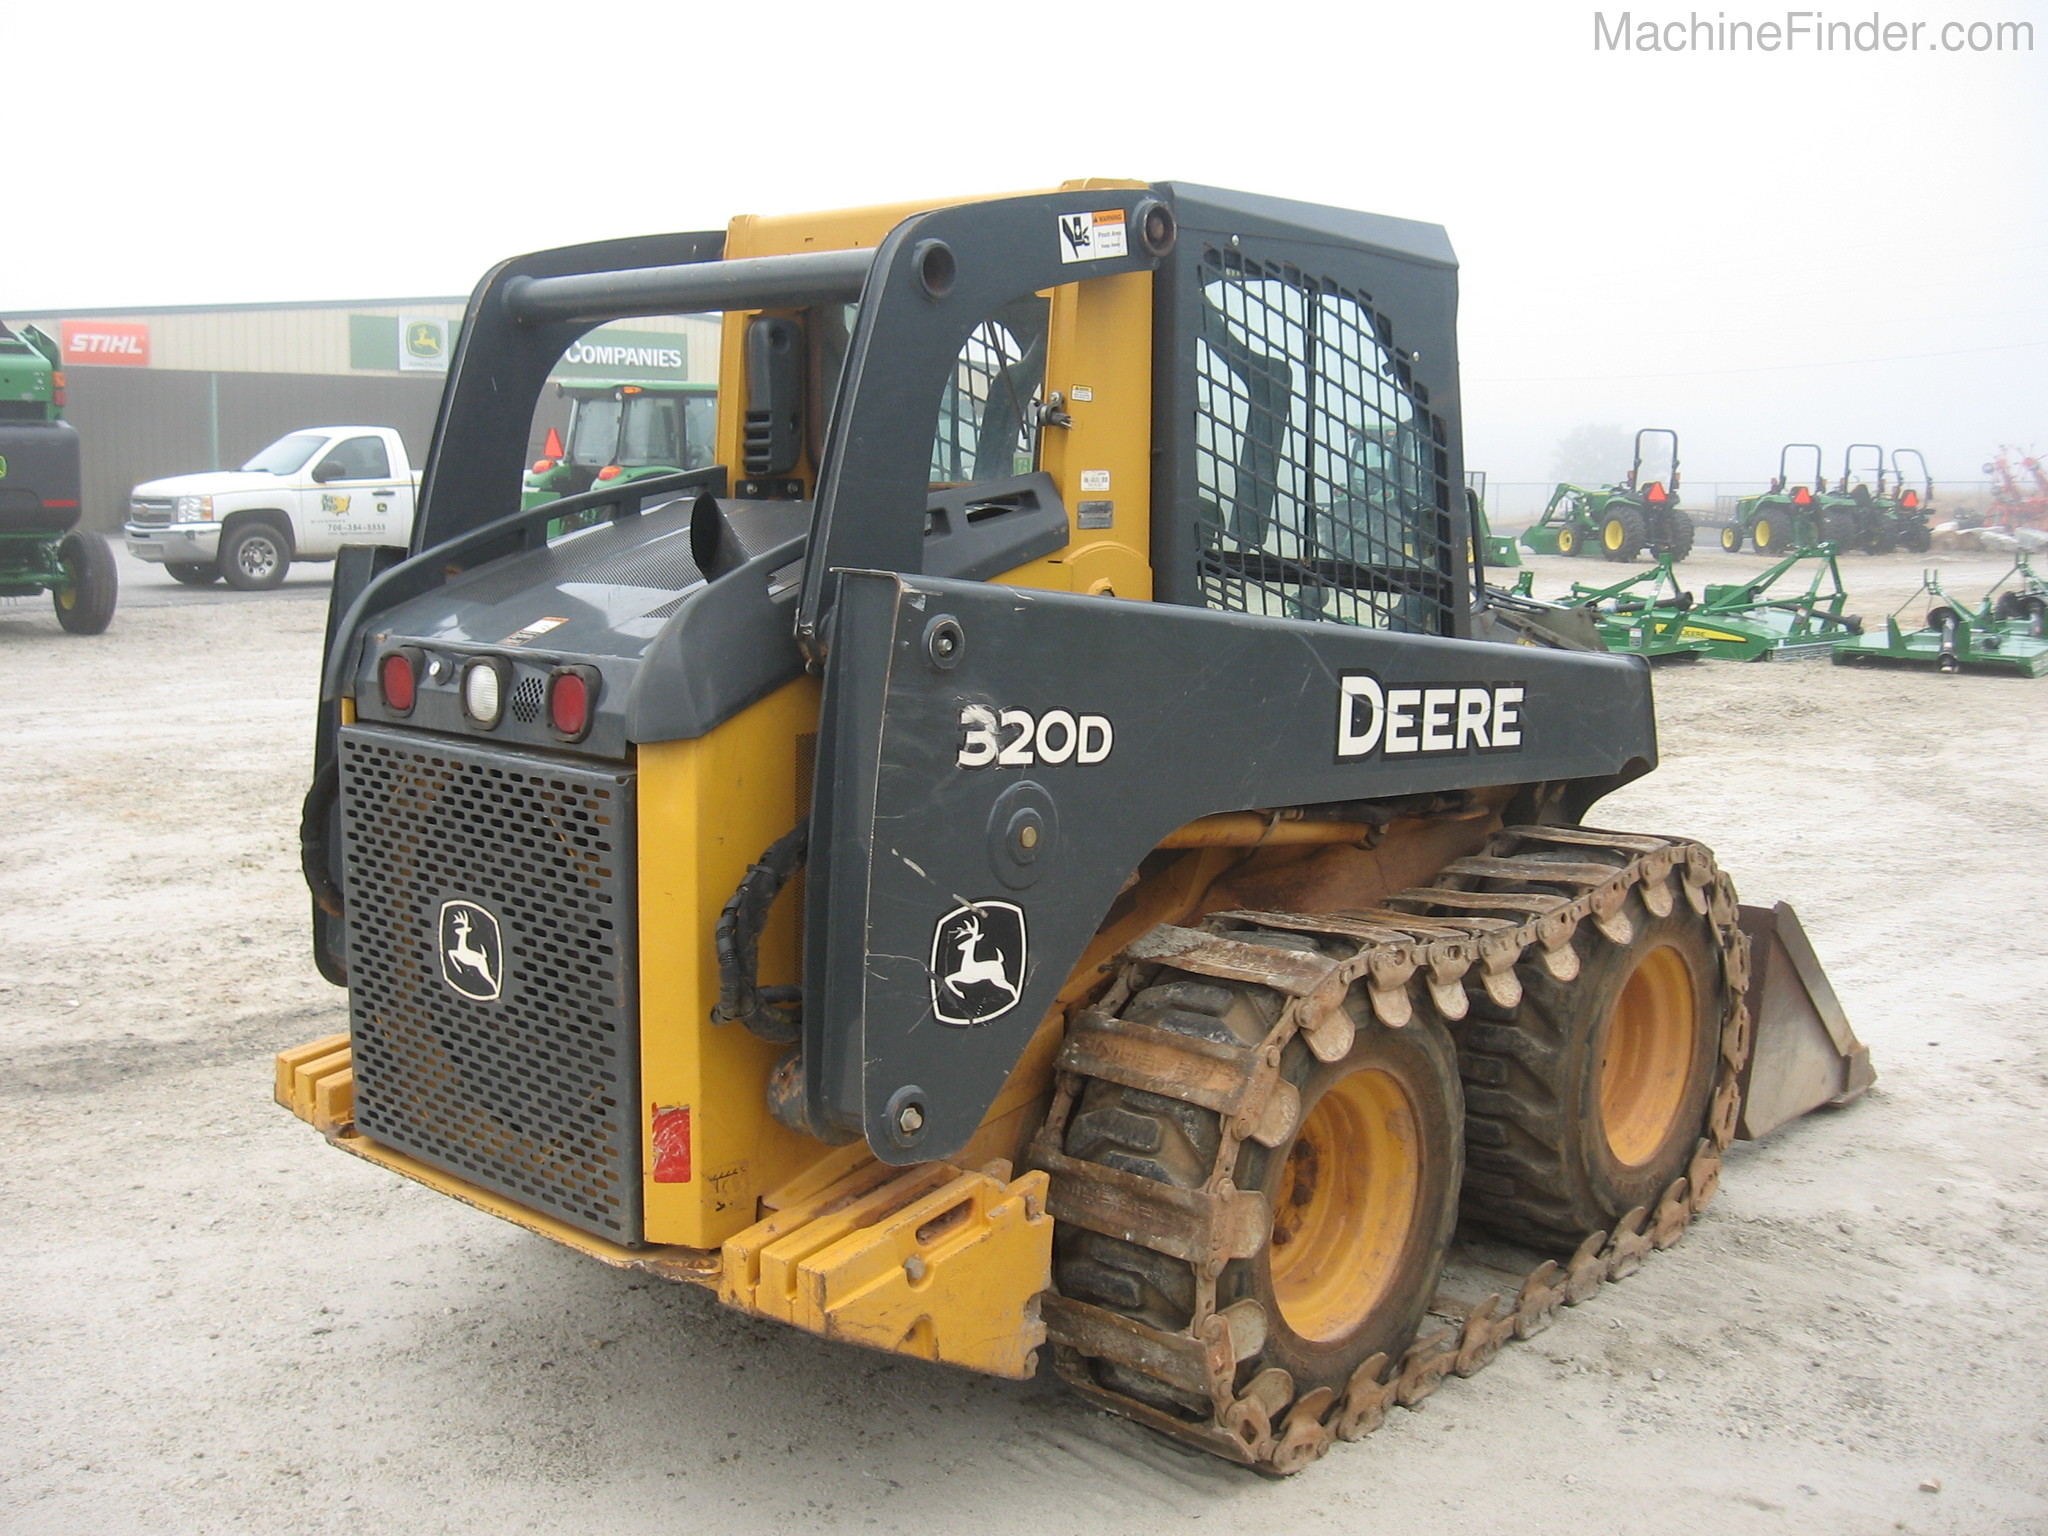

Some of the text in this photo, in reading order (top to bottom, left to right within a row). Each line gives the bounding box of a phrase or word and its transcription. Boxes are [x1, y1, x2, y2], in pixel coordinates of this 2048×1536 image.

[69, 333, 144, 355] STIHL
[565, 341, 682, 368] COMPANIES
[957, 704, 1114, 767] 320D
[1338, 675, 1525, 756] DEERE
